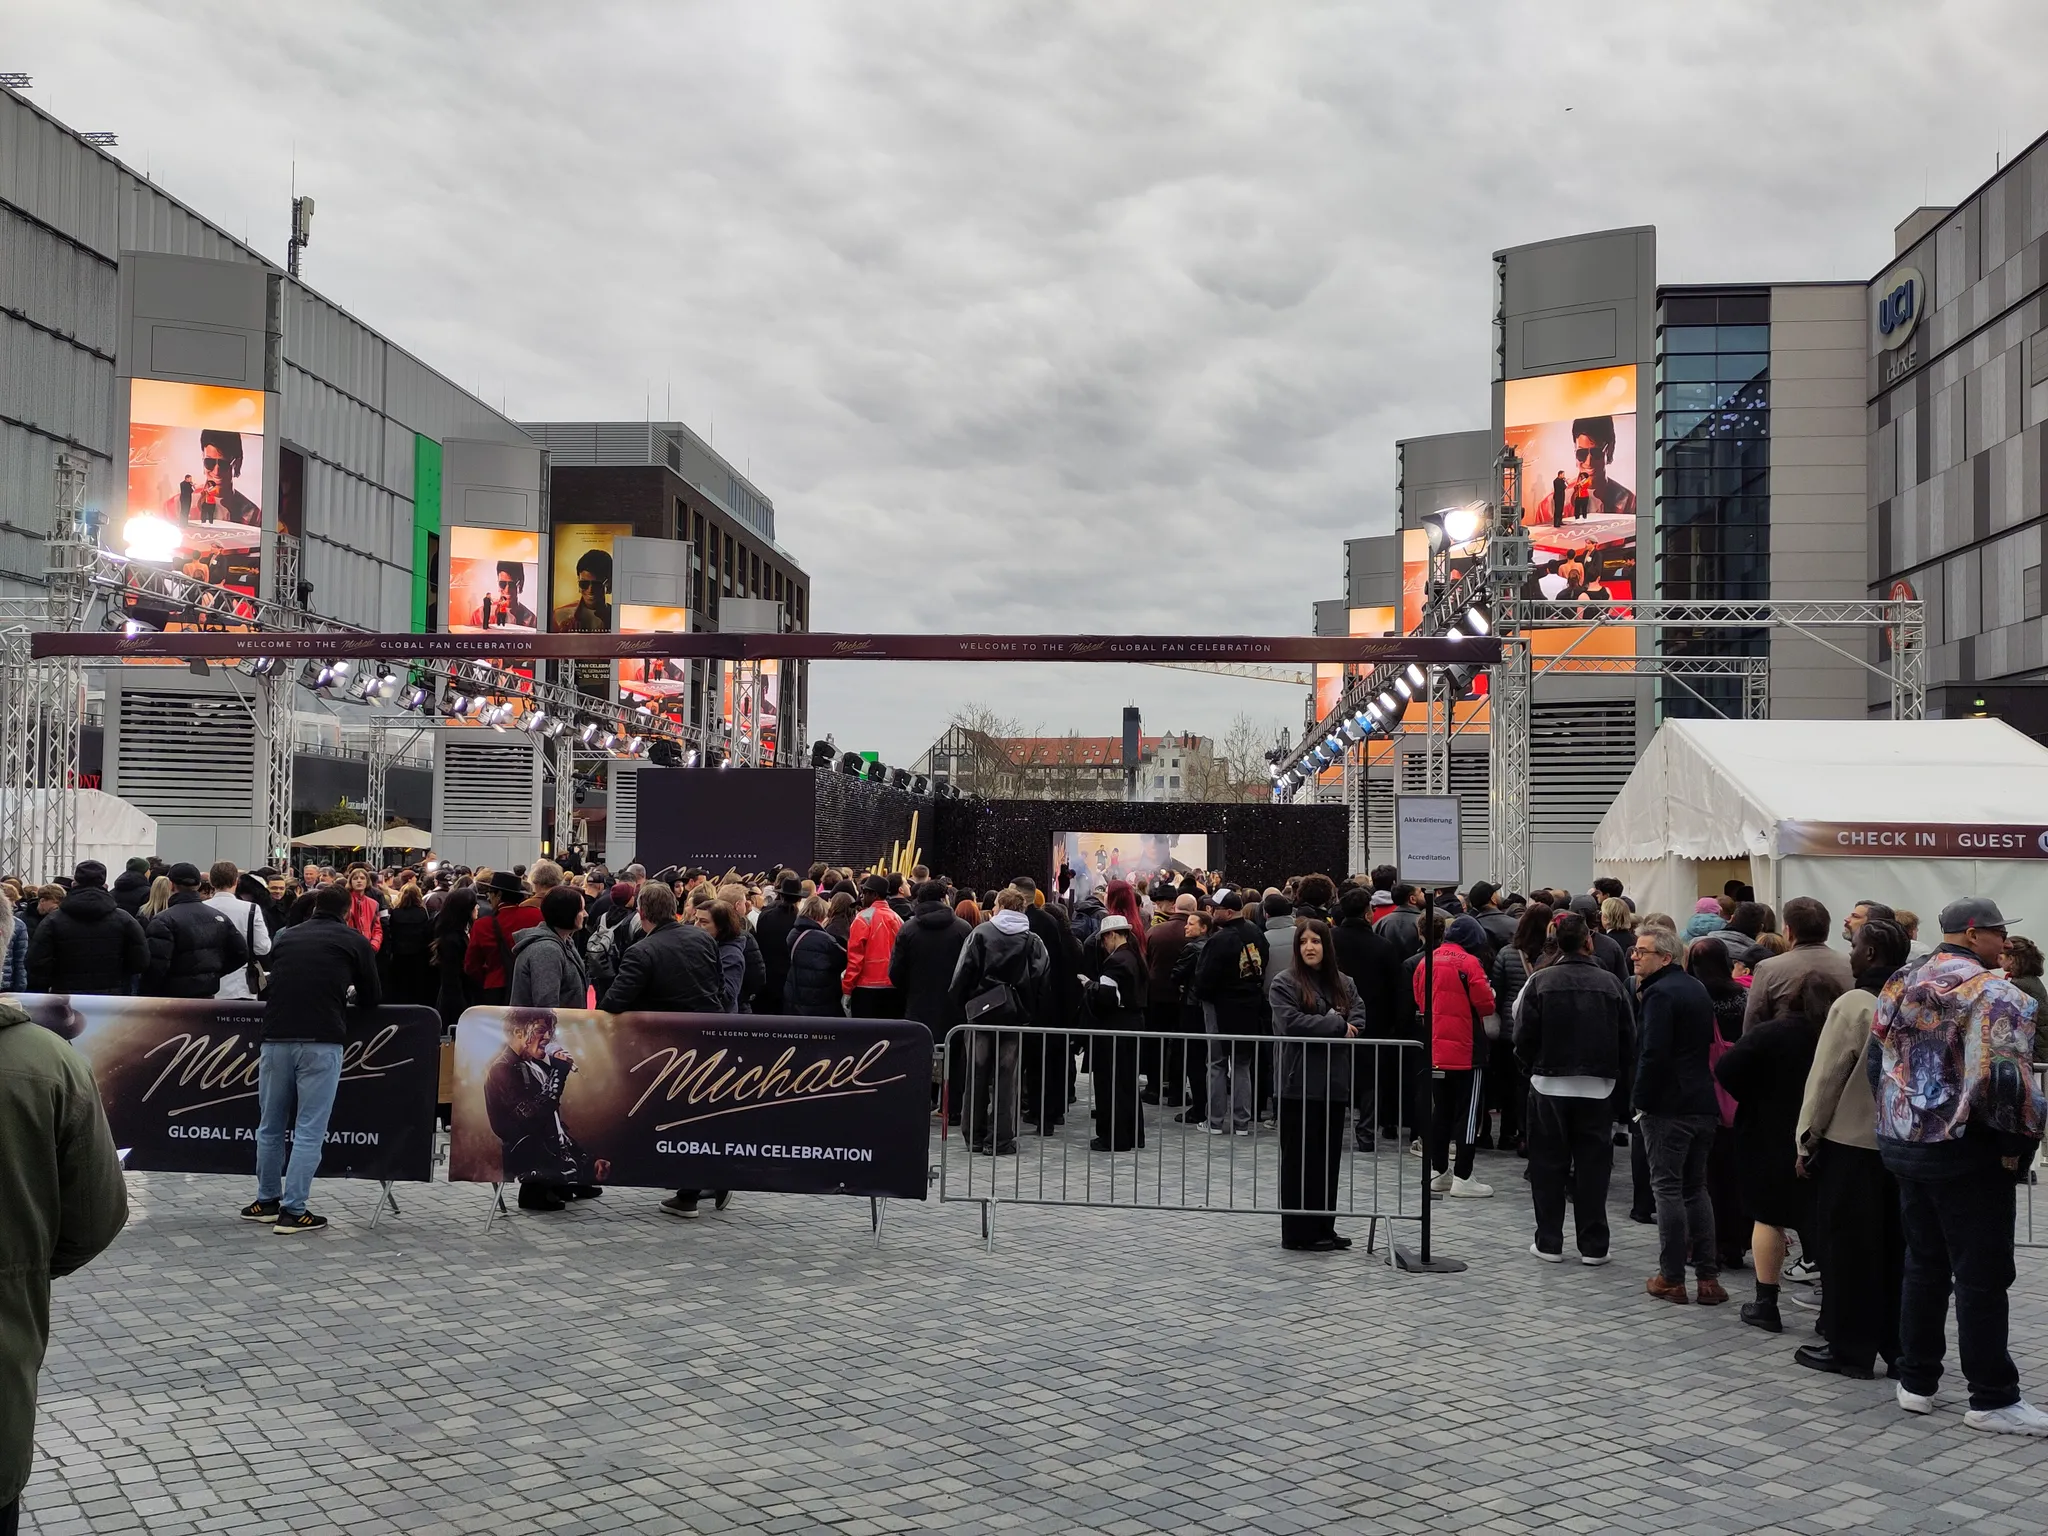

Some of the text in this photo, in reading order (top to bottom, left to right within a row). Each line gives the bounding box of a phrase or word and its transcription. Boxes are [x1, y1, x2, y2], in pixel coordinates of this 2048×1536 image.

[1879, 279, 1914, 335] UCI
[1886, 352, 1917, 382] LUXE
[115, 637, 156, 651] Michael
[236, 640, 292, 648] WELCOME
[341, 638, 376, 651] Michael
[380, 641, 424, 649] GLOBAL
[455, 642, 533, 650] CELEBRATION
[616, 639, 658, 652] Michael
[832, 639, 874, 652] Michael
[959, 641, 1272, 654] WELCOME TO THE Michael GLOBAL FAN CELEBRATION
[1360, 641, 1404, 657] Michael
[1404, 816, 1453, 824] Akkreditierung
[1837, 831, 1907, 846] CHECK
[1915, 832, 1936, 847] IN
[1958, 833, 2027, 848] GUEST
[1407, 853, 1451, 861] Accreditation
[628, 1040, 907, 1118] Michael
[168, 1125, 231, 1141] GLOBAL
[234, 1128, 255, 1141] FA
[656, 1140, 873, 1162] GLOBAL FAN CELEBRATION
